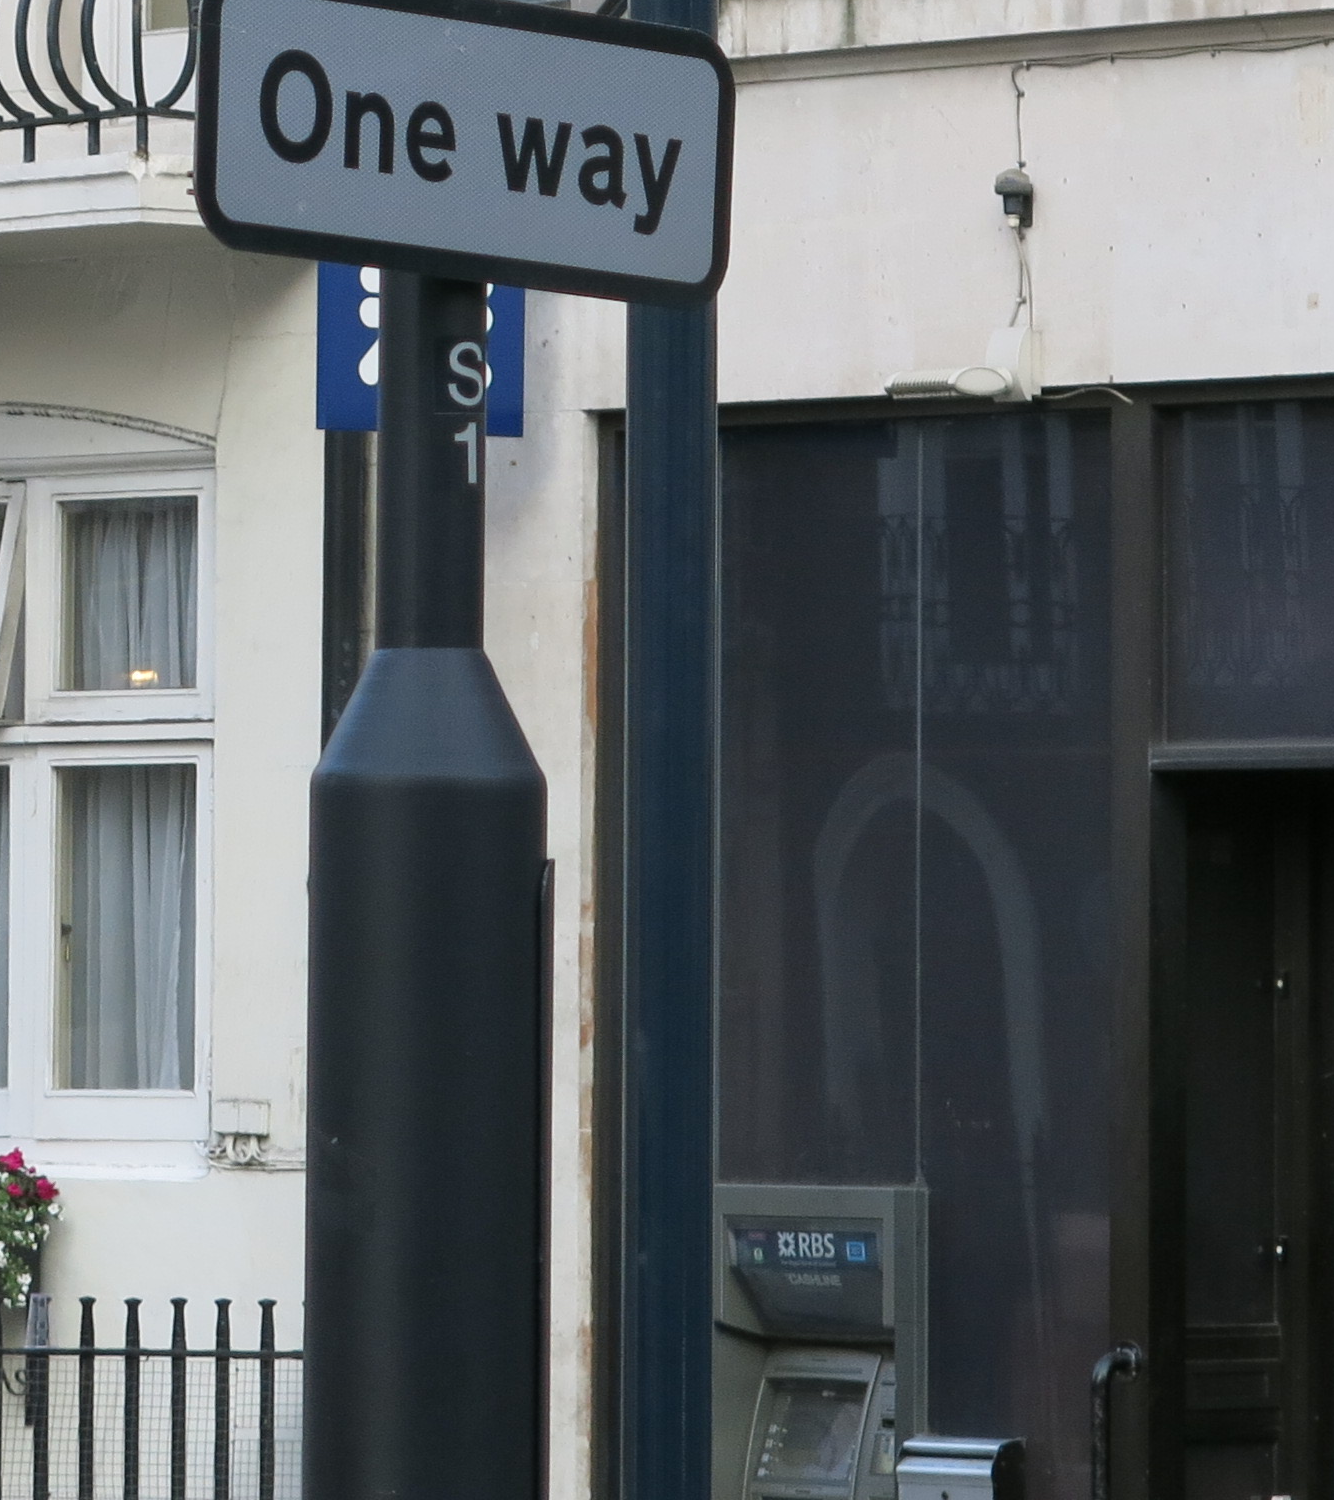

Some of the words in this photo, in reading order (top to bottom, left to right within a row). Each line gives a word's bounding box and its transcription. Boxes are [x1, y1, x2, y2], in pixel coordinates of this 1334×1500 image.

[258, 48, 457, 184] One
[495, 111, 684, 237] way
[448, 341, 485, 406] S
[454, 421, 478, 485] 1
[798, 1232, 836, 1258] RBS
